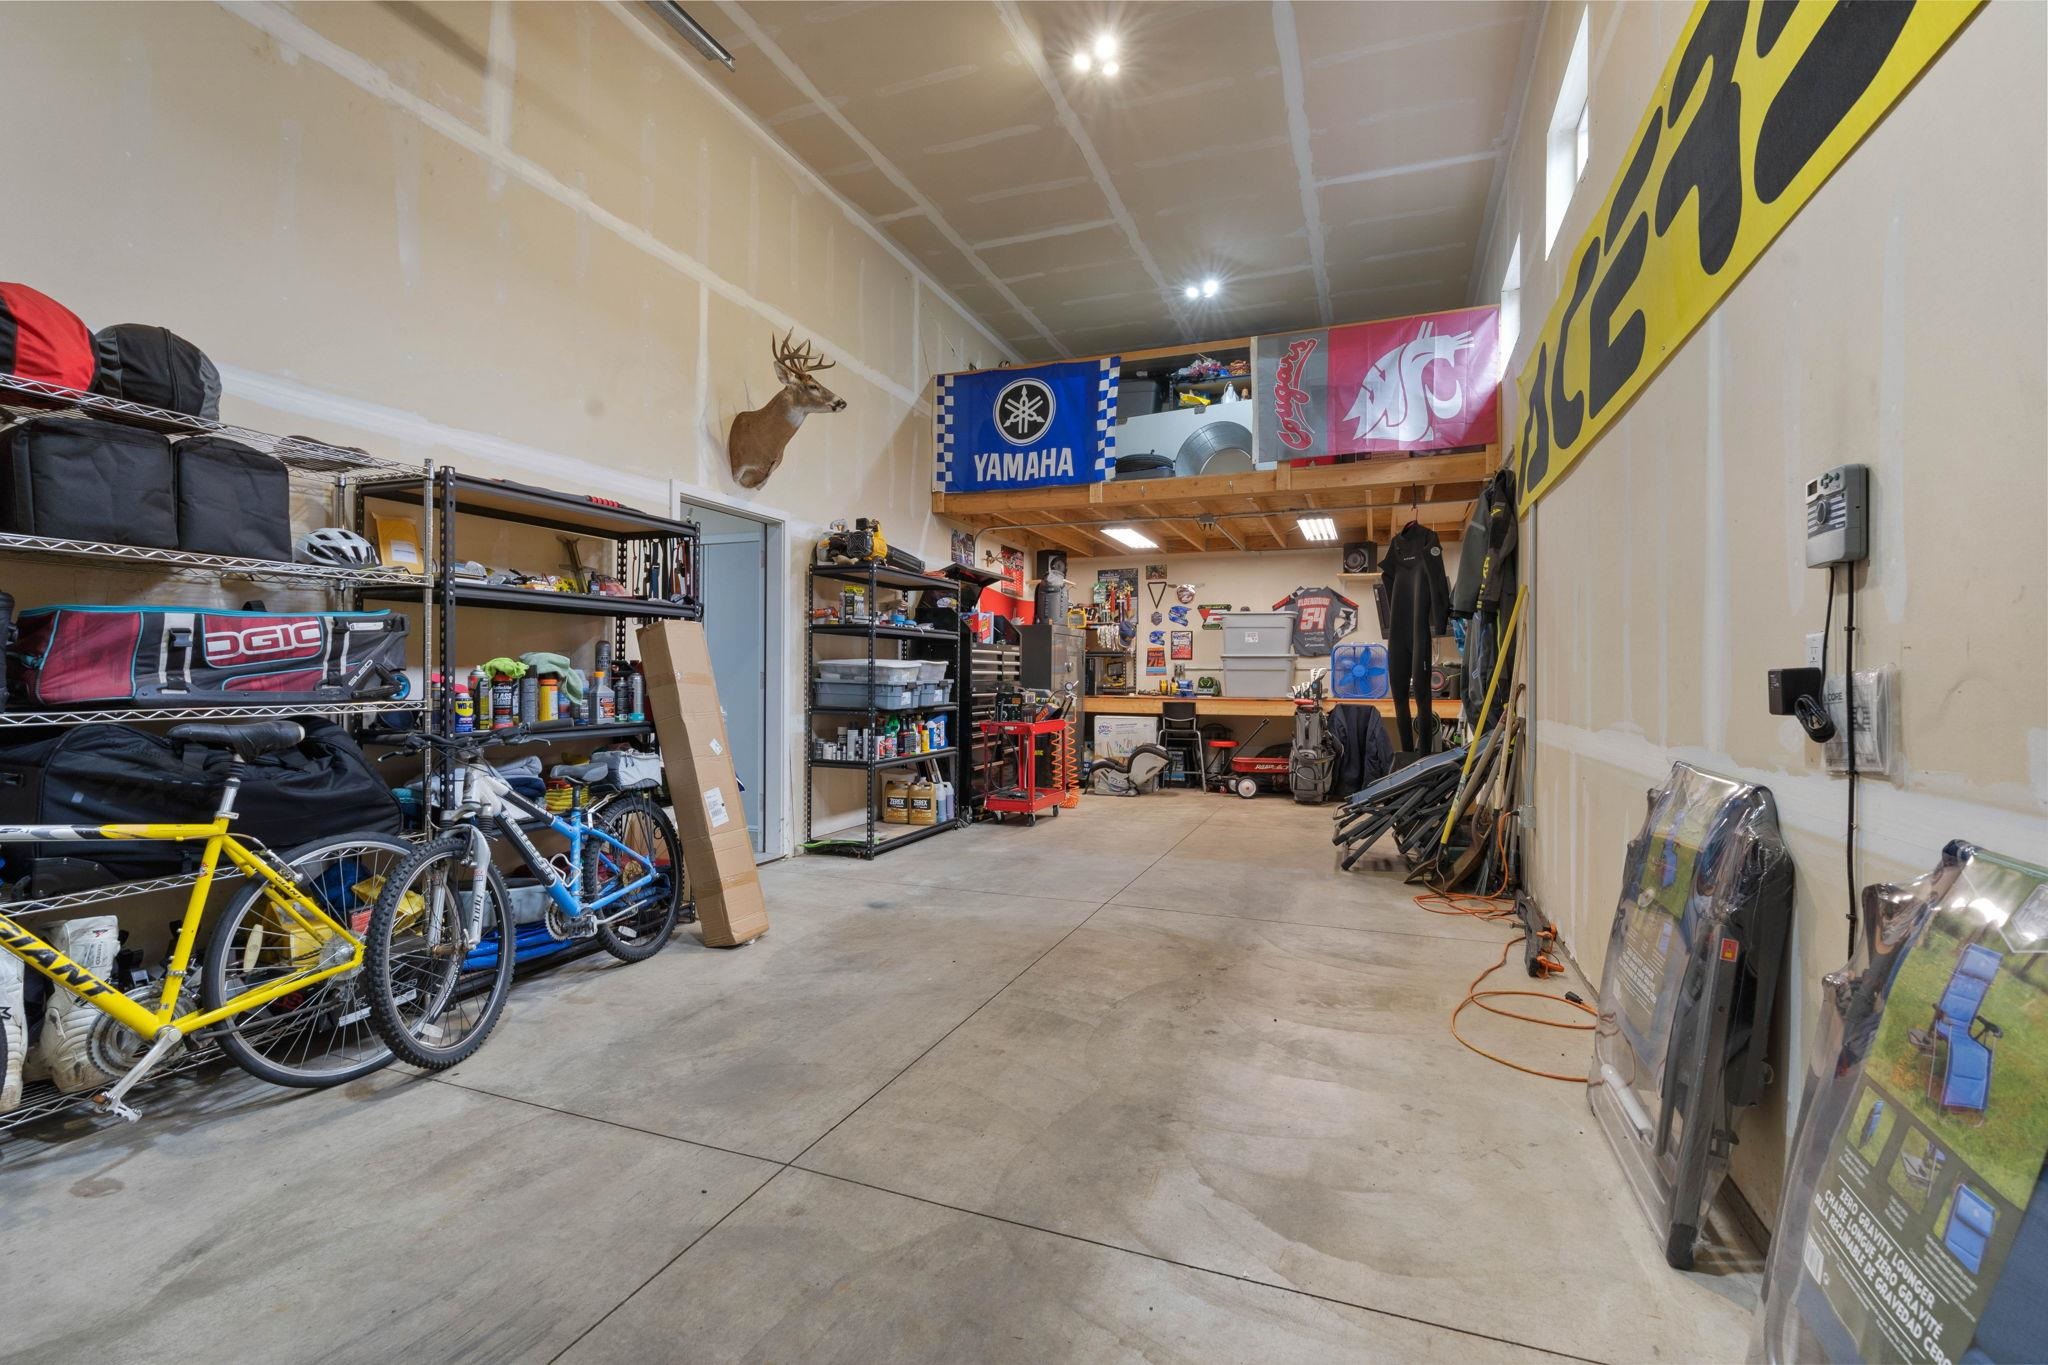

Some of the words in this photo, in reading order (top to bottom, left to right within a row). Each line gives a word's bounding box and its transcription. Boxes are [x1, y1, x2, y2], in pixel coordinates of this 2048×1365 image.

[1273, 338, 1318, 450] Cougars
[974, 447, 1074, 482] YAMAHA
[348, 659, 373, 687] SLED
[1300, 607, 1327, 630] 54
[1825, 1190, 1848, 1223] CHAISE
[1847, 1218, 1876, 1259] LONGUE
[1898, 1284, 1944, 1340] GRAVITÉ
[1829, 1213, 1866, 1267] RECLINABLE
[1863, 1261, 1877, 1281] DE
[1875, 1277, 1922, 1339] GRAVEDAD
[1840, 1188, 1858, 1215] ZERO
[1859, 1212, 1893, 1256] GRAVITY
[1892, 1253, 1935, 1309] LOUNGER
